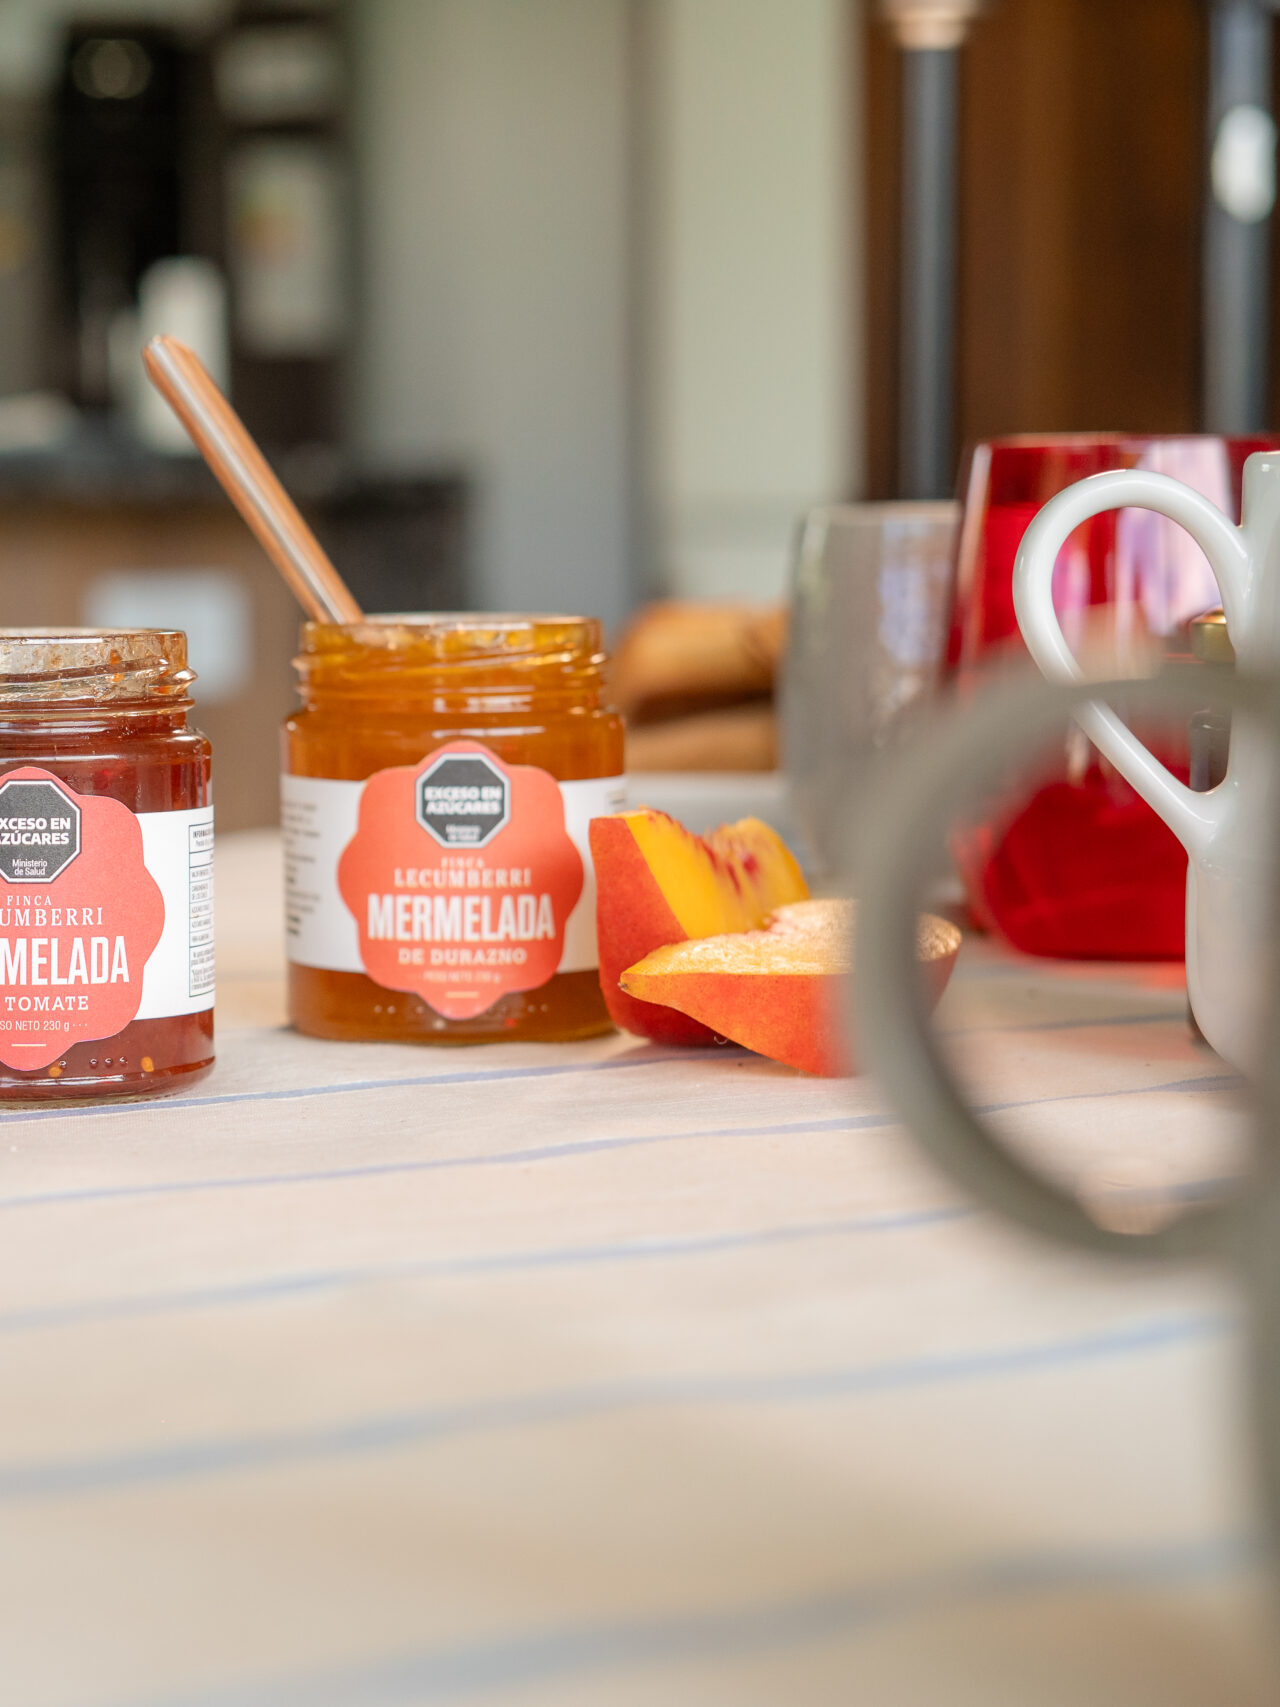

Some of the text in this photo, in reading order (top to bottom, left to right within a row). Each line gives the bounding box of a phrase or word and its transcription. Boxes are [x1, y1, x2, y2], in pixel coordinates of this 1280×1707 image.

[424, 786, 502, 801] EXCESO EN
[50, 817, 71, 830] EN
[12, 858, 48, 869] Ministerio
[14, 867, 46, 876] de Salud
[394, 867, 532, 888] LECUMBERRI
[6, 895, 52, 906] FINCA
[367, 893, 555, 942] MERMELADA
[398, 947, 528, 966] DE DURAZNO
[4, 995, 89, 1011] TOMATE
[15, 1020, 40, 1031] NETO
[43, 1020, 61, 1031] 230
[63, 1023, 70, 1032] g
